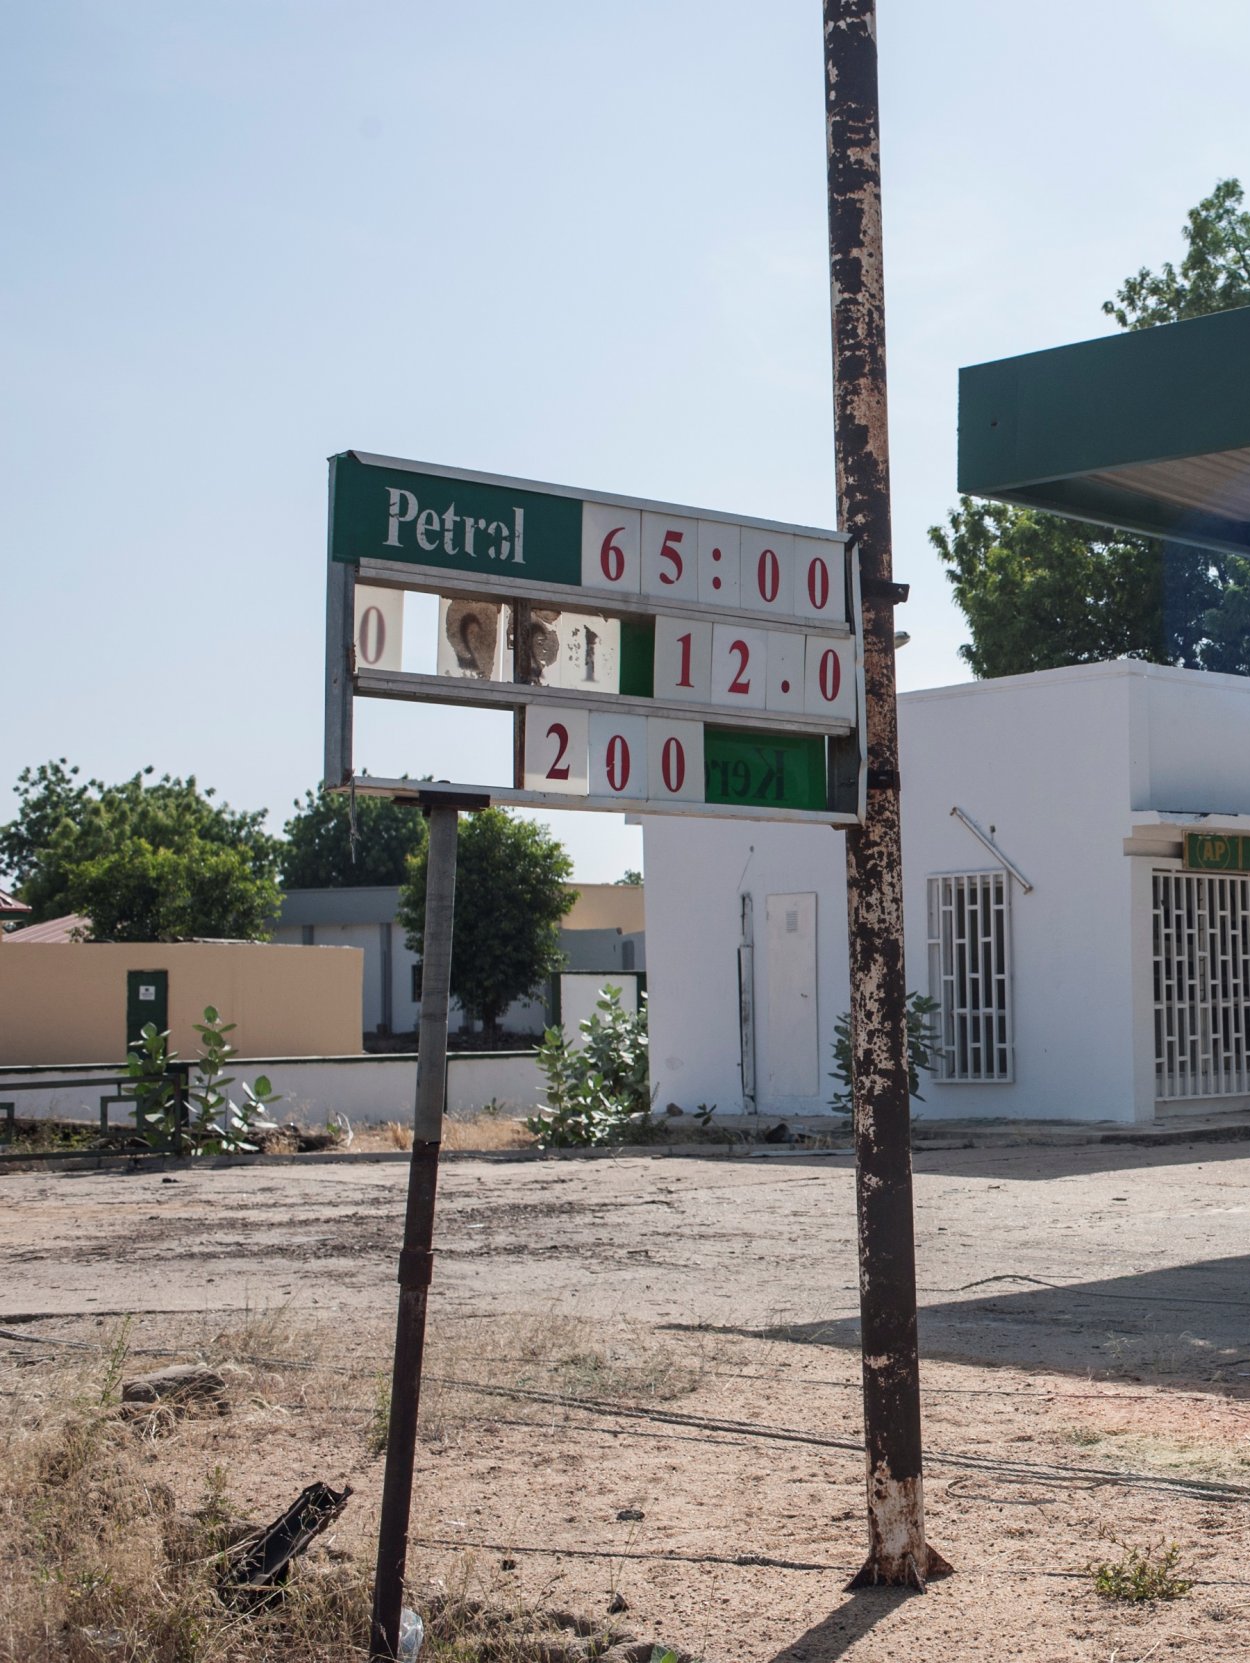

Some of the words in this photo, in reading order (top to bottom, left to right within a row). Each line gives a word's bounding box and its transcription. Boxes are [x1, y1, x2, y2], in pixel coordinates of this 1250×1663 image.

[383, 485, 526, 565] Petrol
[599, 526, 830, 610] 65:00
[676, 632, 842, 702] 12.0
[545, 722, 687, 794] 200
[1203, 840, 1226, 862] AP
